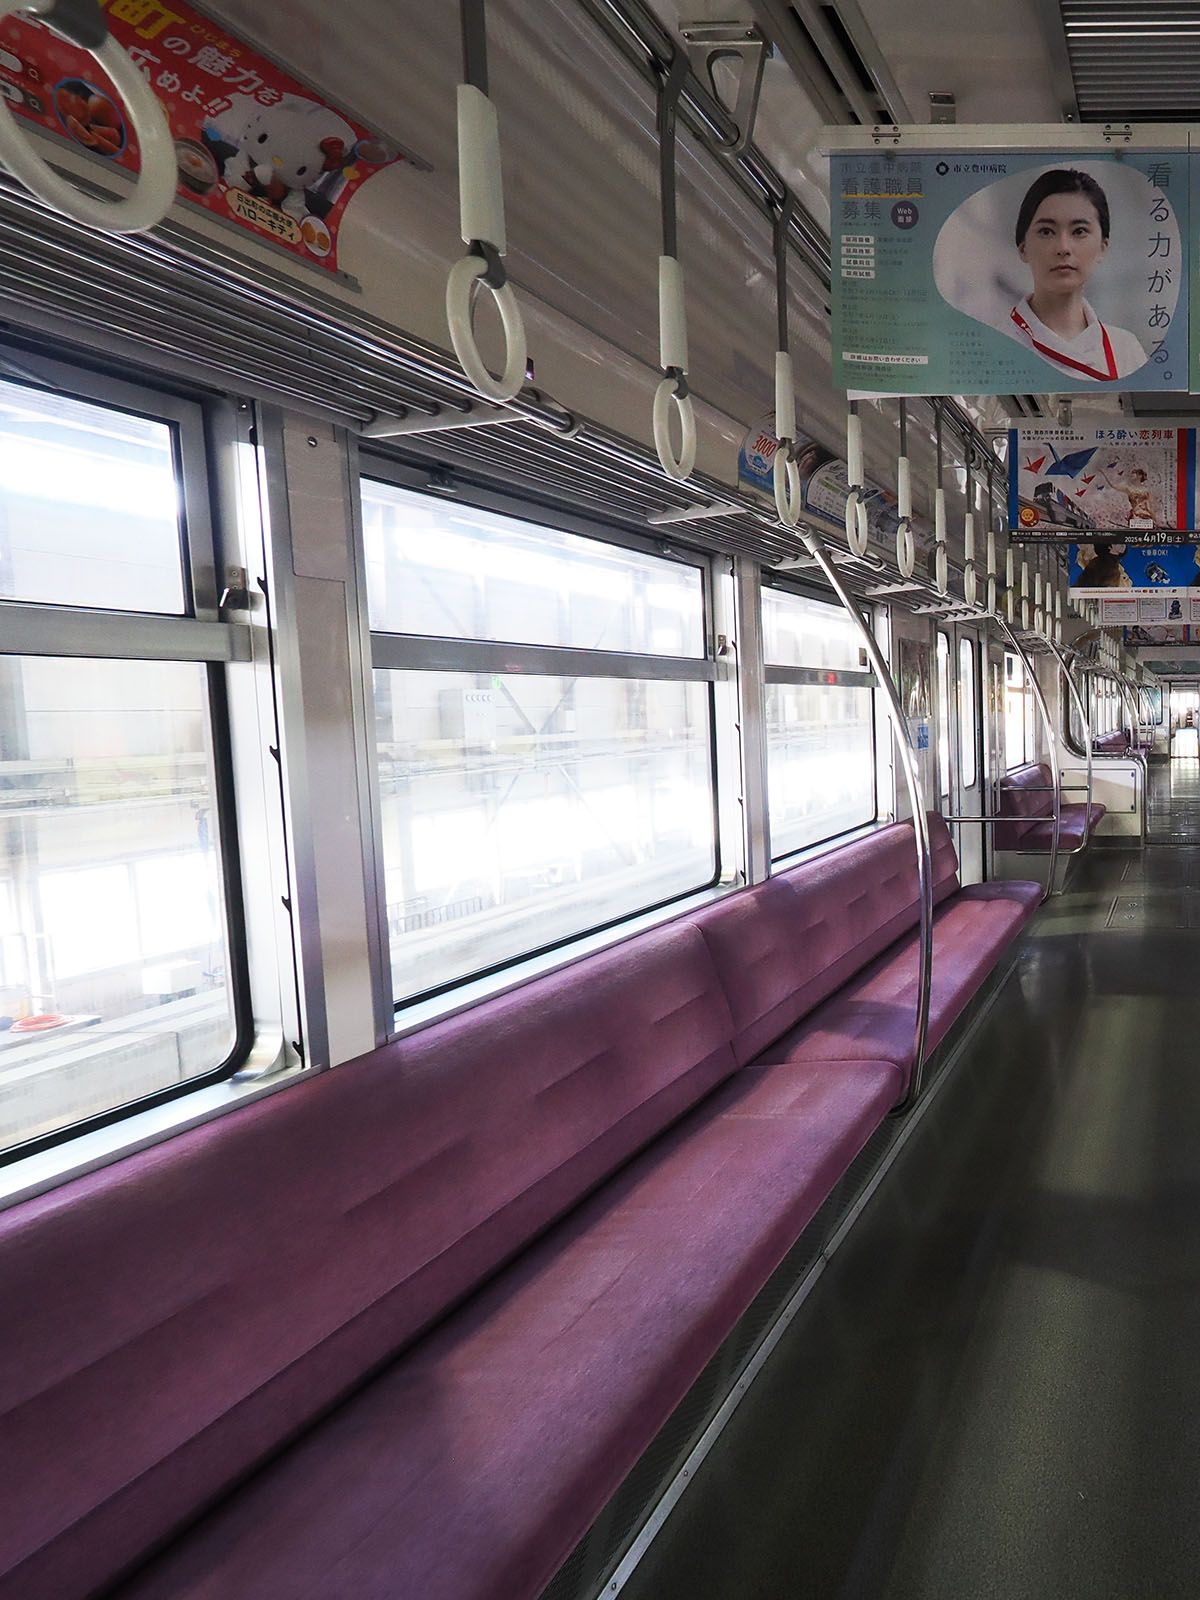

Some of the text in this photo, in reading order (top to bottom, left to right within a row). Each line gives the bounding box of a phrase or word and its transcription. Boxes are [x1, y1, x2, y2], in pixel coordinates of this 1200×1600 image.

[953, 163, 1008, 174] 市立豊中病院
[841, 177, 924, 196] 看護職員
[842, 201, 882, 221] 募集
[897, 207, 913, 216] Web
[236, 204, 295, 241] ハローキティ
[1147, 161, 1173, 382] 看る力がある。
[1095, 429, 1174, 441] ほろ酔い恋列車
[751, 433, 777, 459] 3000
